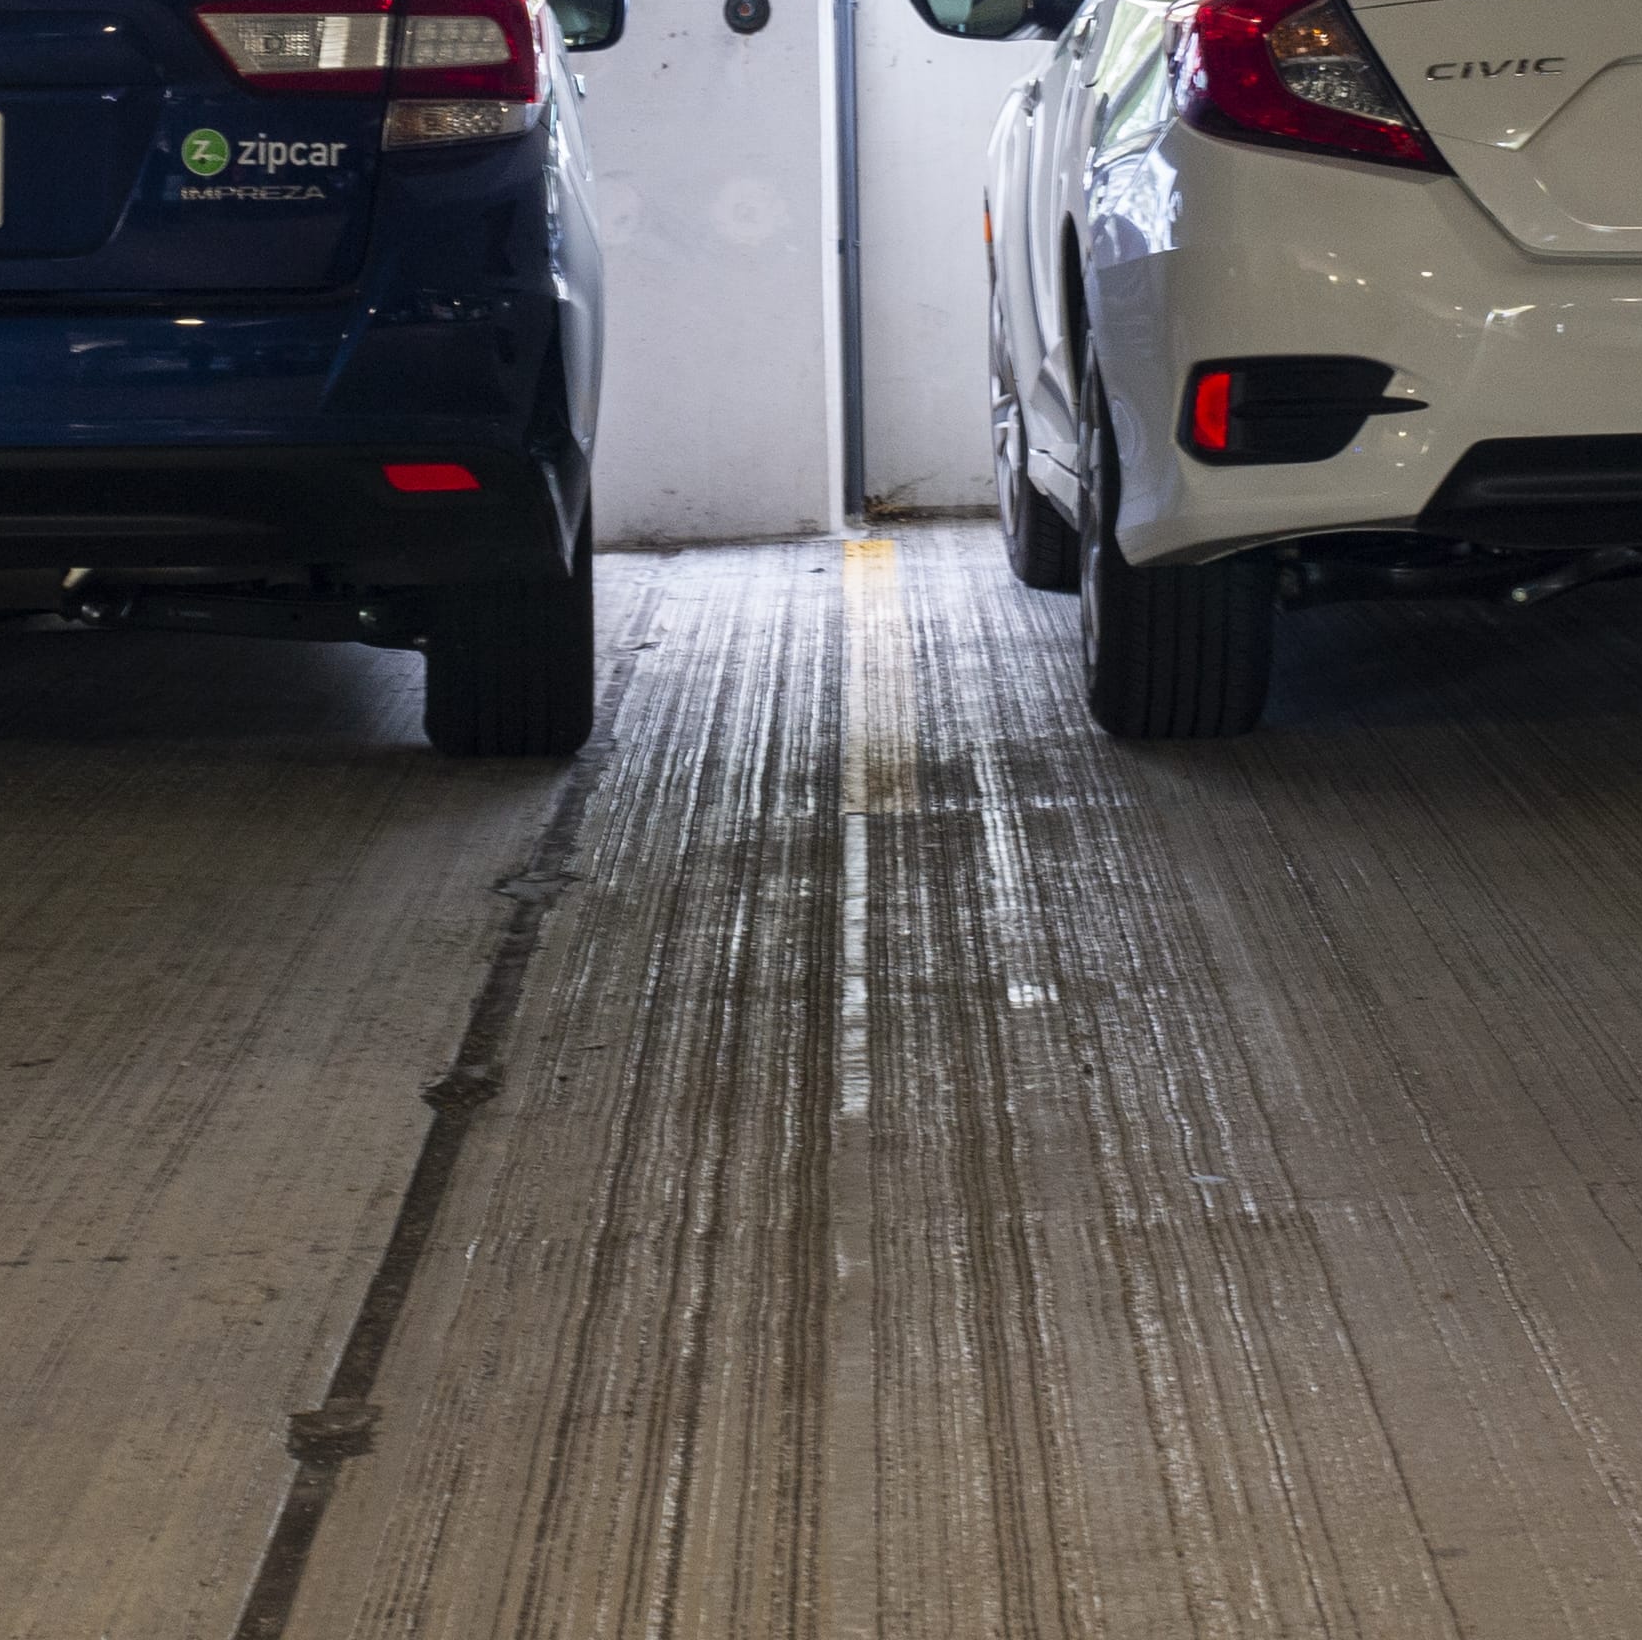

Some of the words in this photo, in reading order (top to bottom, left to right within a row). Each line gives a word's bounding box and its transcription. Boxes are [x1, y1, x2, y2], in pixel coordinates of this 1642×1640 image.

[1425, 57, 1565, 81] CIVIC
[237, 132, 347, 174] zipcar
[180, 185, 326, 201] IMPREZA
